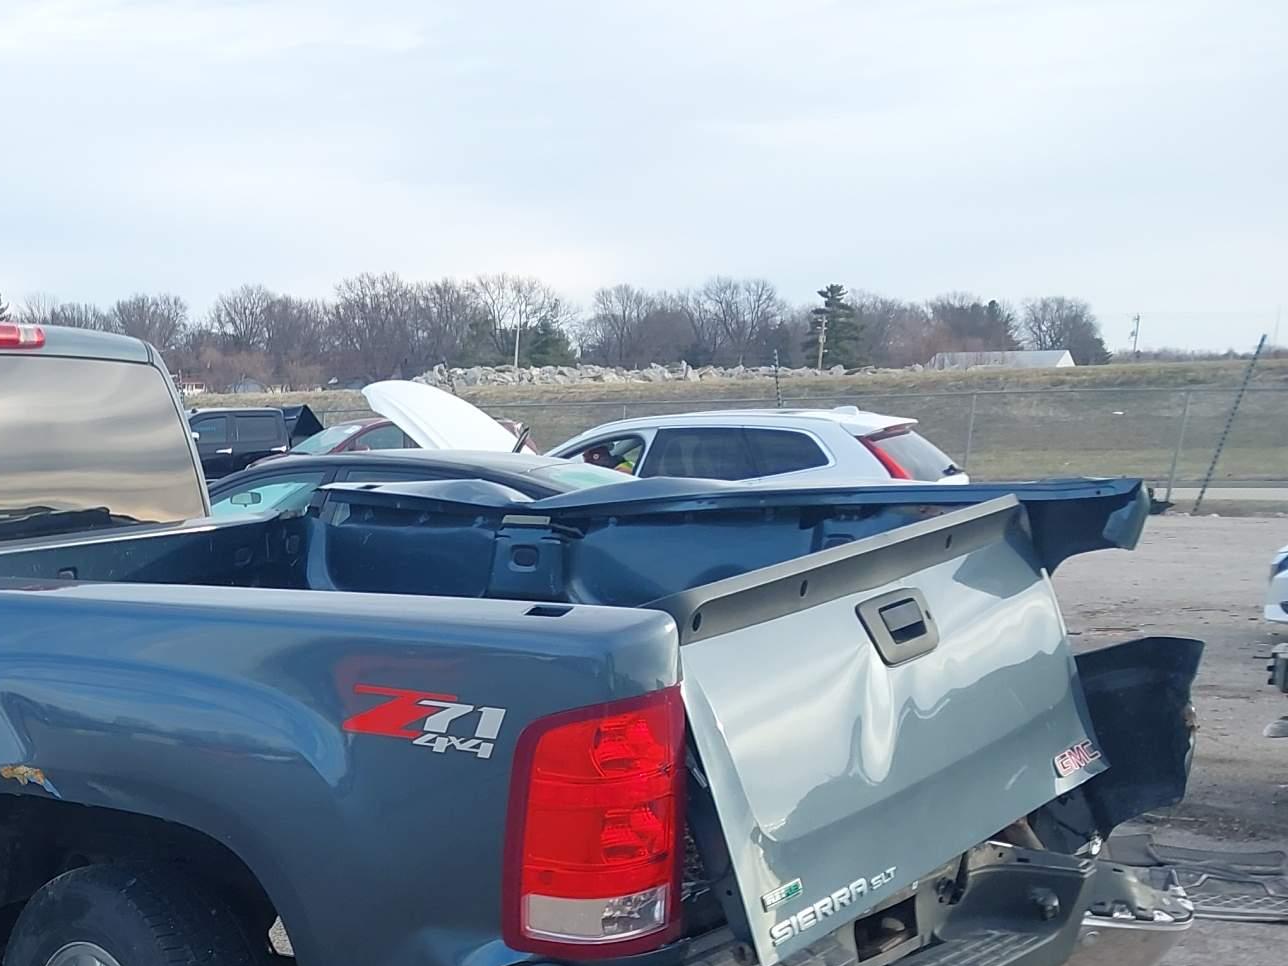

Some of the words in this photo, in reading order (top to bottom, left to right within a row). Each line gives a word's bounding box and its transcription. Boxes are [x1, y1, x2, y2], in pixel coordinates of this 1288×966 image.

[341, 683, 508, 741] Z71
[1053, 738, 1102, 777] GMC
[770, 877, 868, 947] SIERRA
[870, 866, 897, 891] SLT
